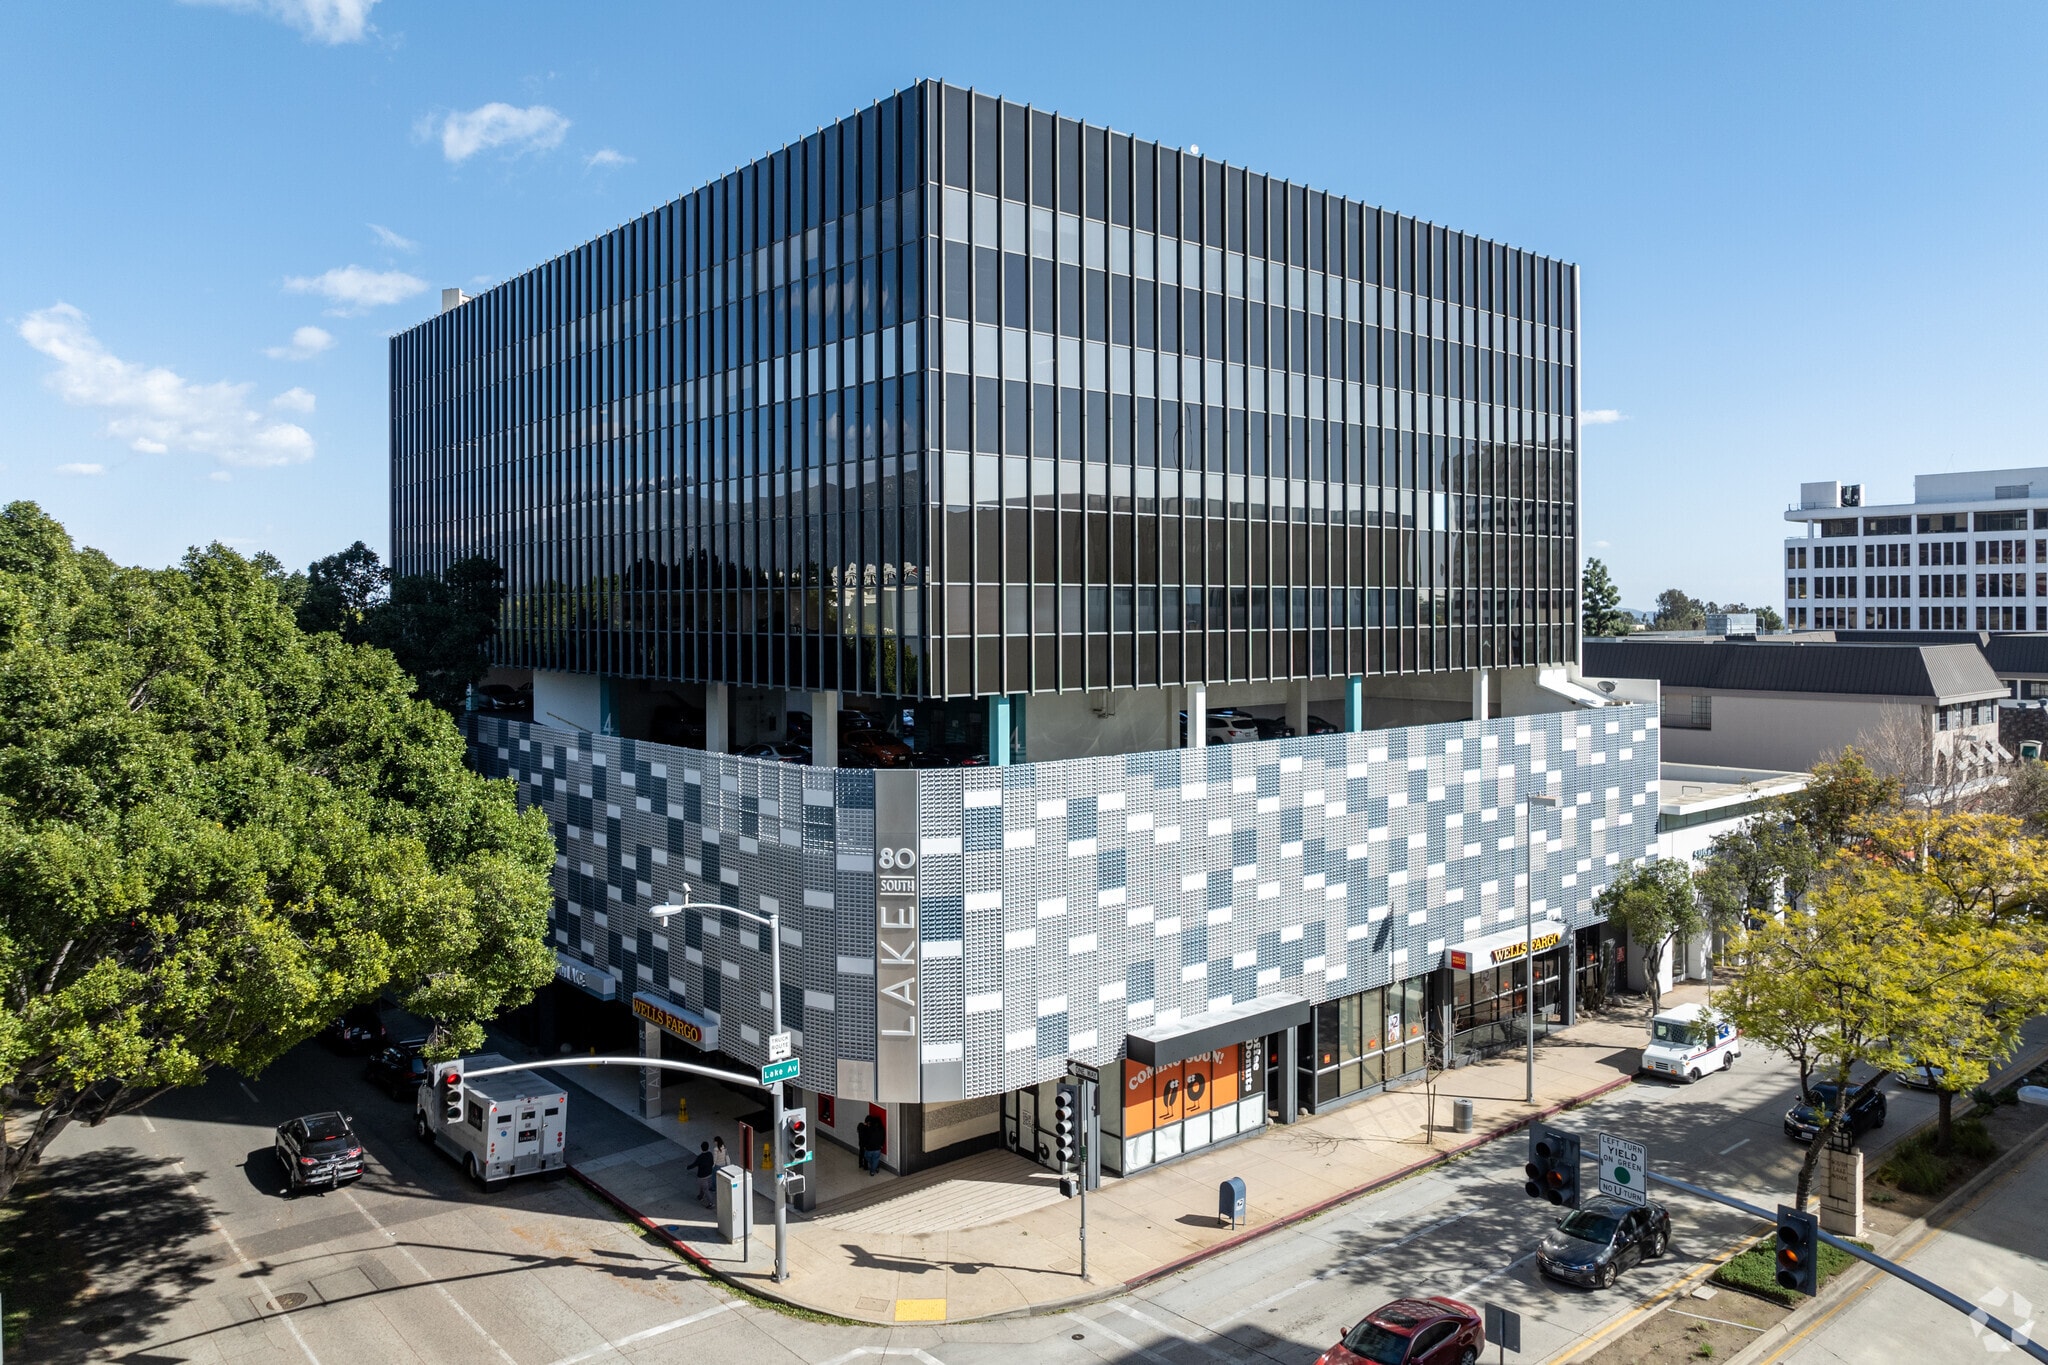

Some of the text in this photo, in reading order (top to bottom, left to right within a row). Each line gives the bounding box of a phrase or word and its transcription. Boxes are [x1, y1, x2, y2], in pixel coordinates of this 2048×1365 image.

[879, 847, 916, 869] 80
[880, 880, 915, 892] SOUTH
[1492, 933, 1560, 962] WELLS FARGO
[880, 906, 915, 1036] LAKE
[633, 1000, 699, 1042] WELLS FARGO
[1253, 1037, 1261, 1071] offee
[765, 1065, 797, 1078] Lake Av
[1602, 1136, 1642, 1154] LEFT TURN
[1608, 1146, 1637, 1161] YIELD
[1603, 1154, 1642, 1172] ON GREEN
[1603, 1183, 1612, 1192] NO
